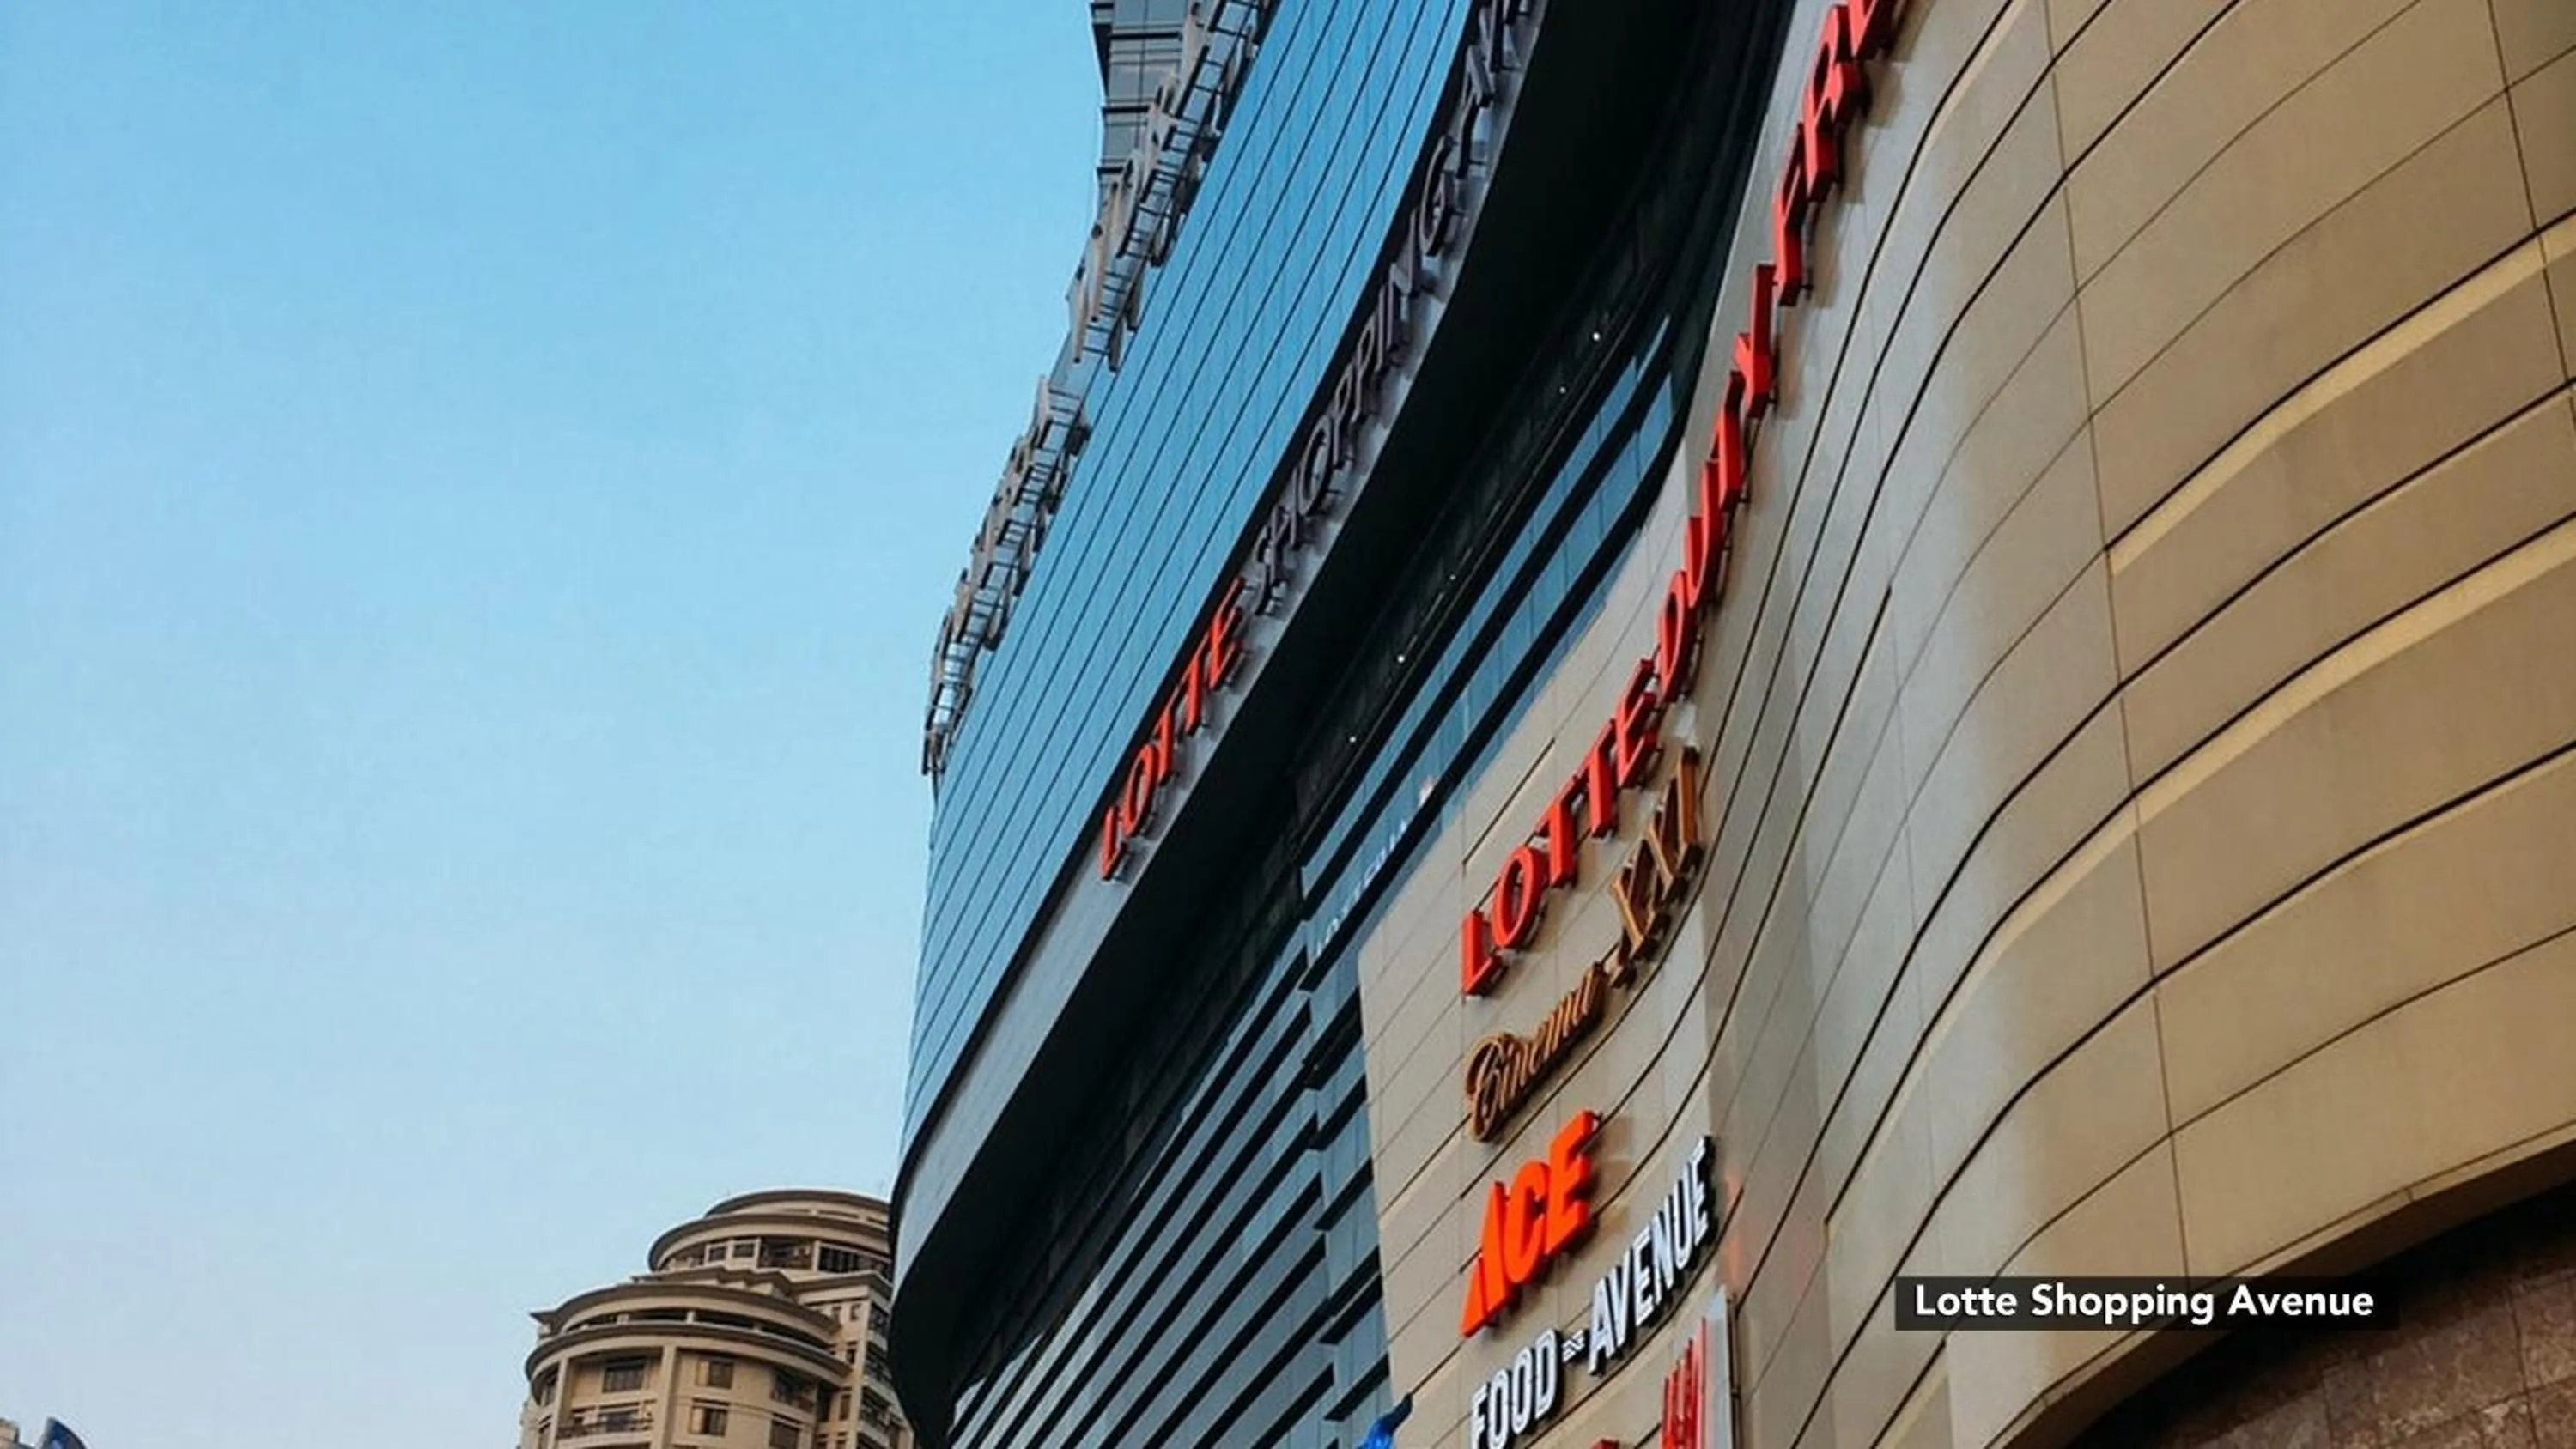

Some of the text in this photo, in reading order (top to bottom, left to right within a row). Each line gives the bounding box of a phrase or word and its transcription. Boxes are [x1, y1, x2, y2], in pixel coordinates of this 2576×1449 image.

[1100, 576, 1246, 881] LOTTE
[1253, 134, 1453, 615] SHOPPING
[1461, 658, 1662, 997] LOTTE
[1465, 961, 1607, 1143] Cinema
[1462, 1110, 1602, 1338] ACE
[1471, 1328, 1564, 1449] FOOD
[1589, 1135, 1711, 1375] AVENUE
